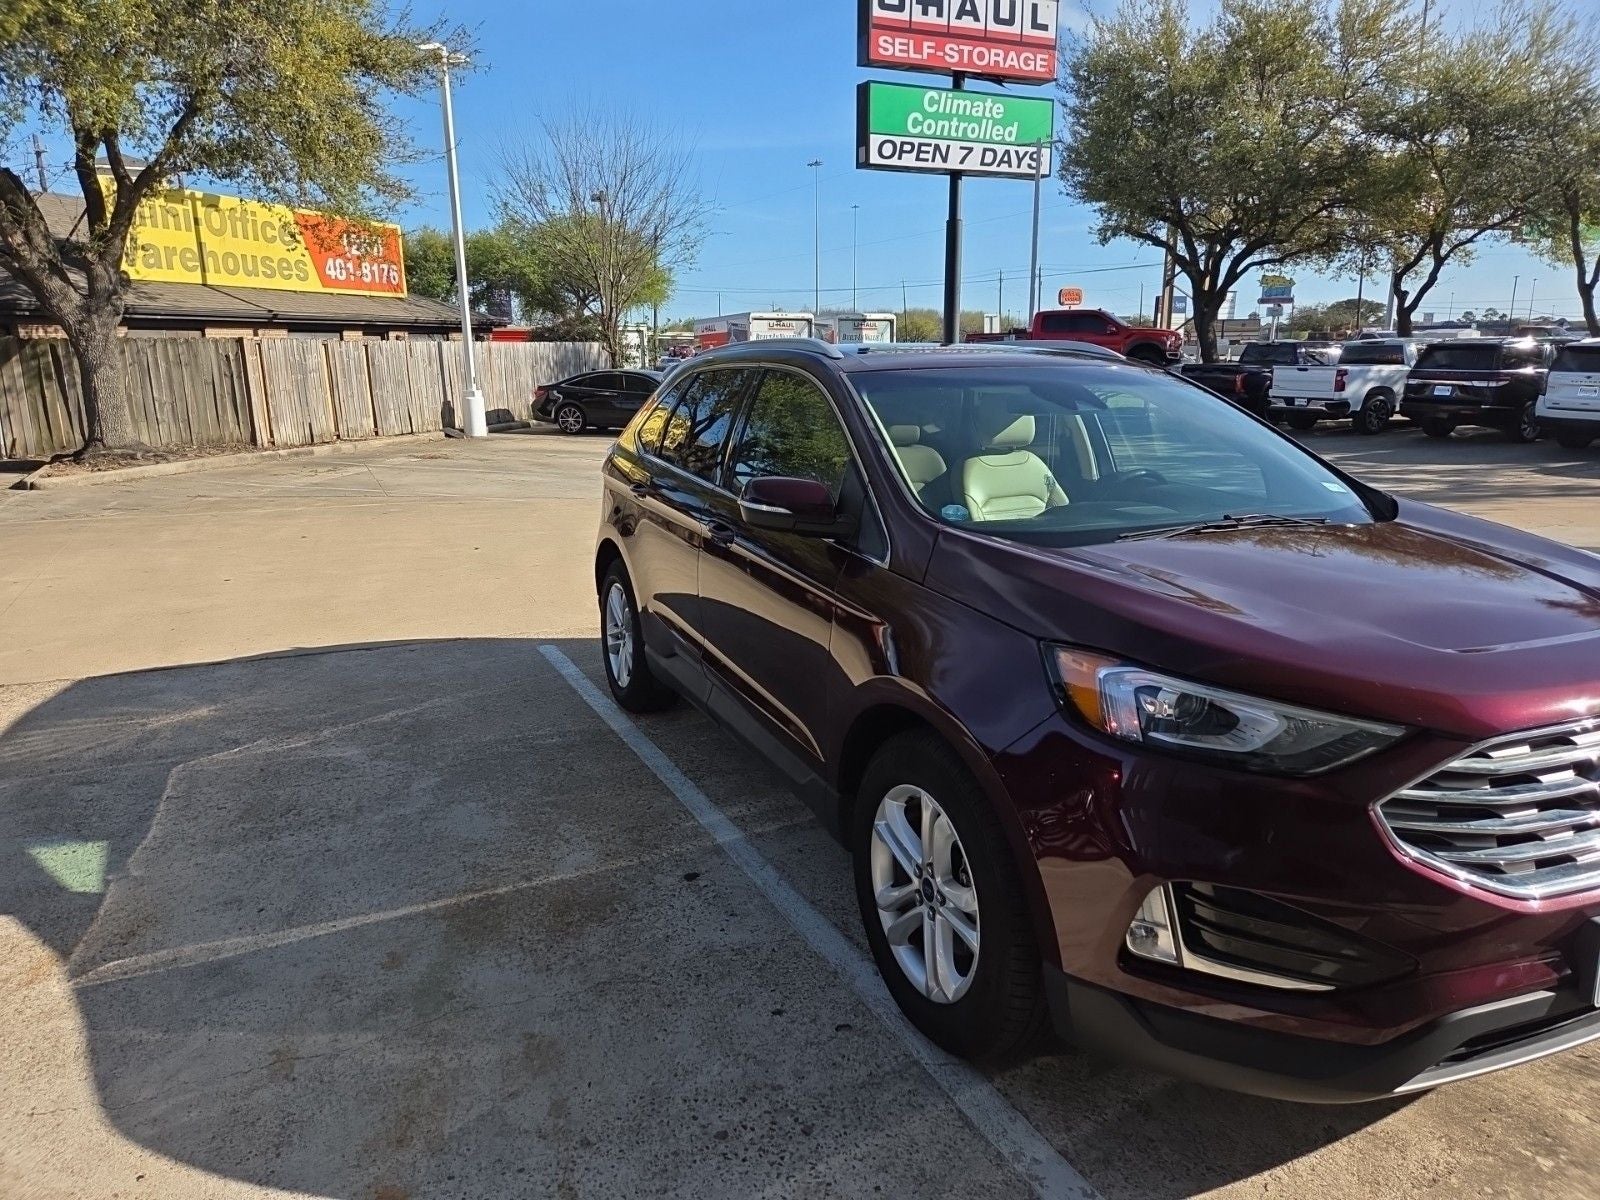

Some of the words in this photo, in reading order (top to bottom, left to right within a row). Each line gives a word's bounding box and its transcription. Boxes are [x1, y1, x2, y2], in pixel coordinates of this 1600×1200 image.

[877, 35, 1049, 73] SELF-STORAGE
[923, 91, 1004, 119] Climate
[907, 112, 1018, 142] Controlled
[877, 139, 951, 165] OPEN
[958, 146, 974, 165] 7
[980, 147, 1043, 170] DAYS
[133, 200, 297, 247] ini-Office
